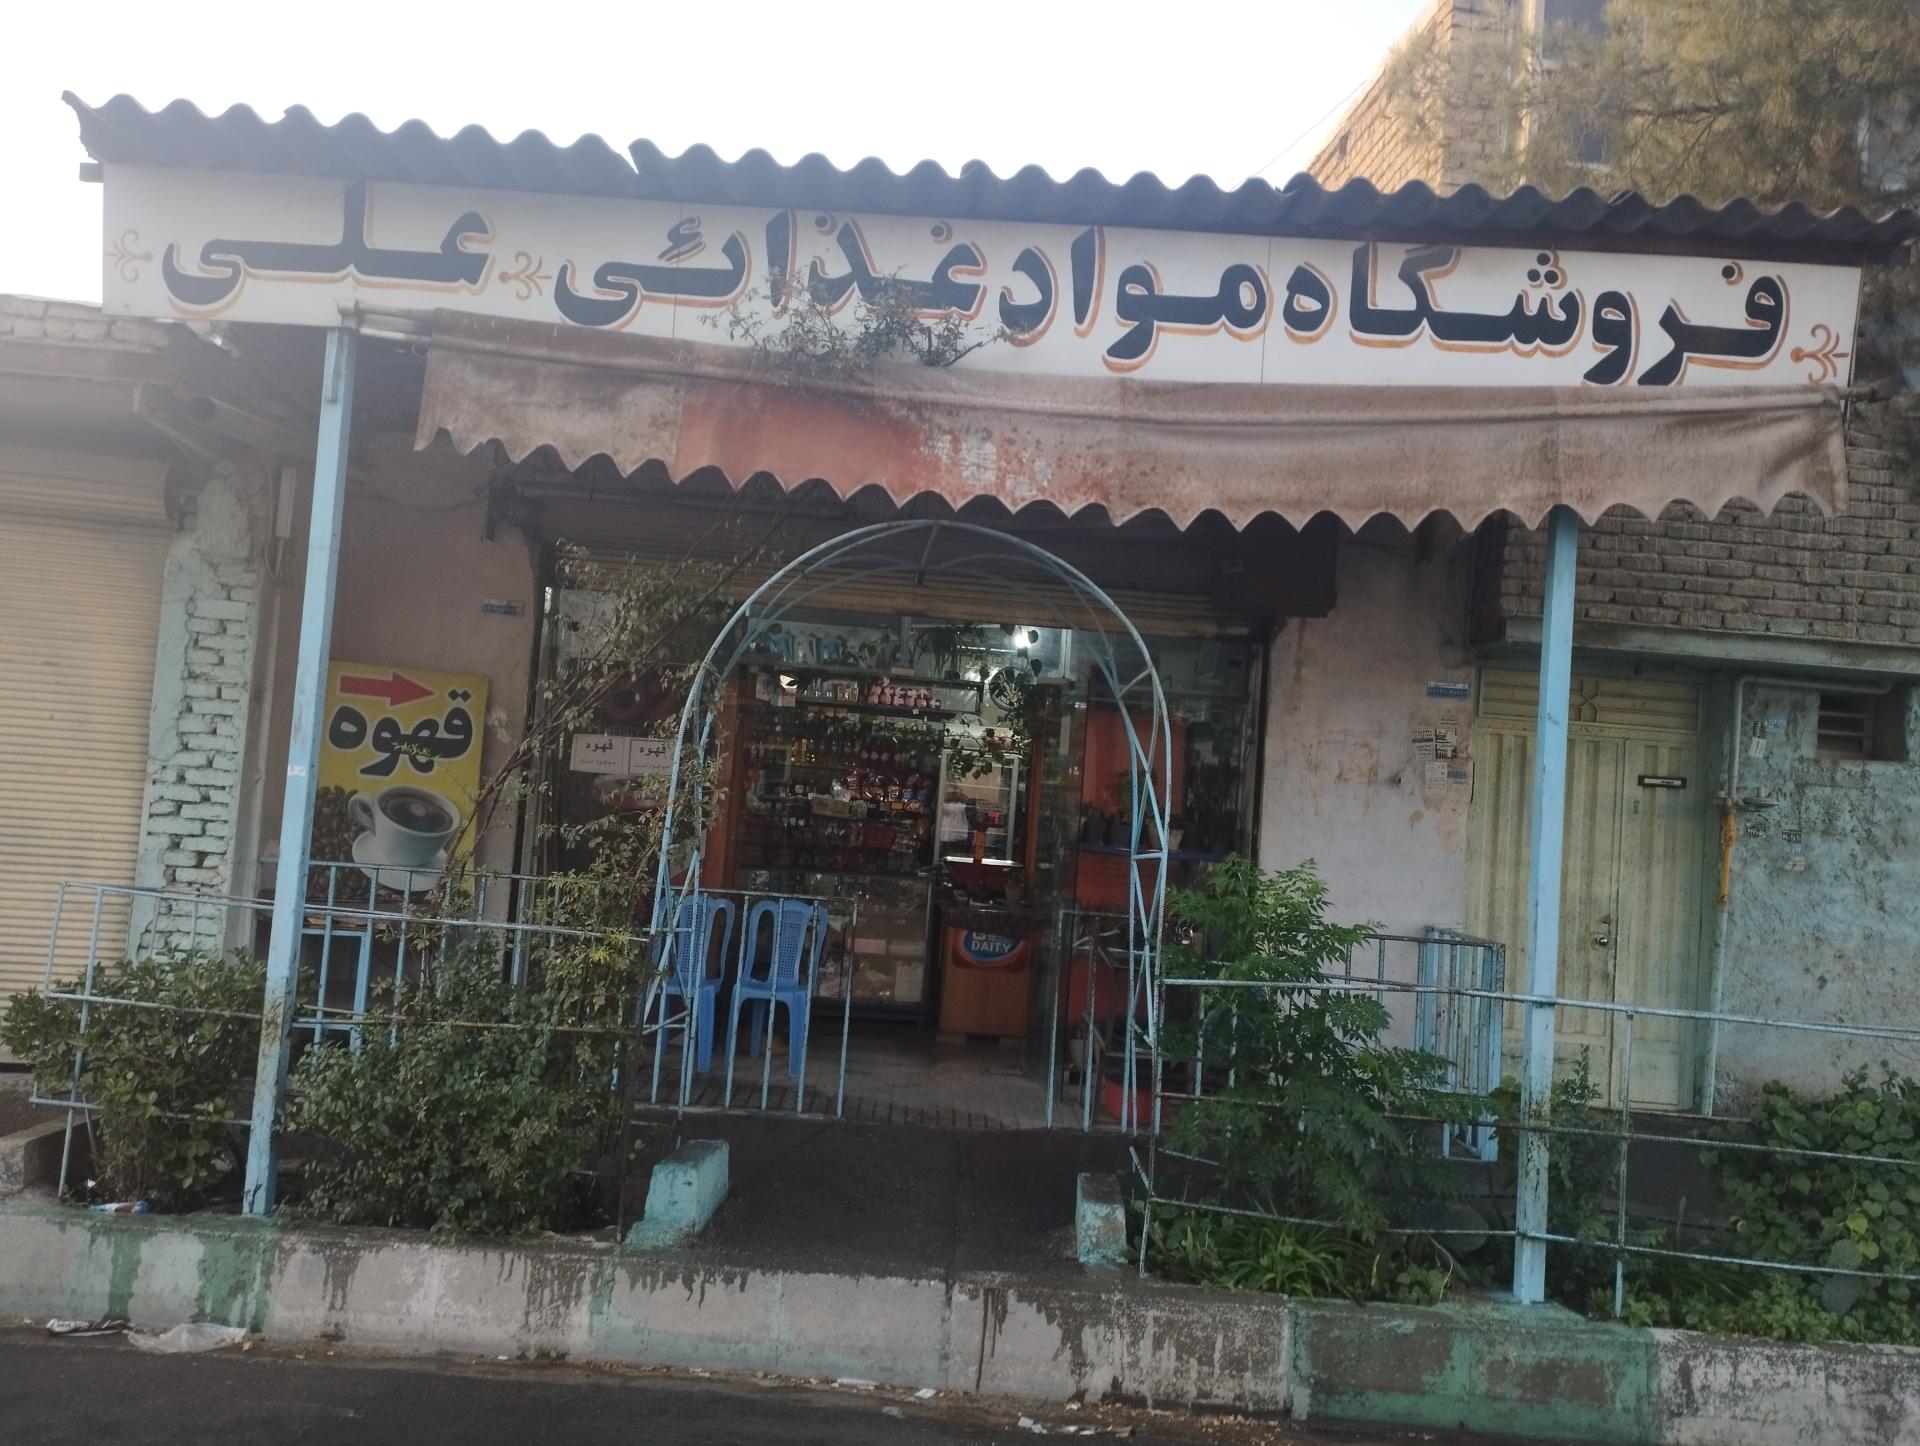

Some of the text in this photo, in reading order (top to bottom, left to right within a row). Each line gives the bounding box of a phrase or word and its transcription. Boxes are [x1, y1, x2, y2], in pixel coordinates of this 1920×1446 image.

[160, 180, 497, 318] علی
[1000, 225, 1273, 373] مواد
[1282, 240, 1790, 387] فروشگاه
[329, 688, 473, 777] قهوه
[586, 739, 613, 752] قهوه
[640, 744, 666, 757] قهوه
